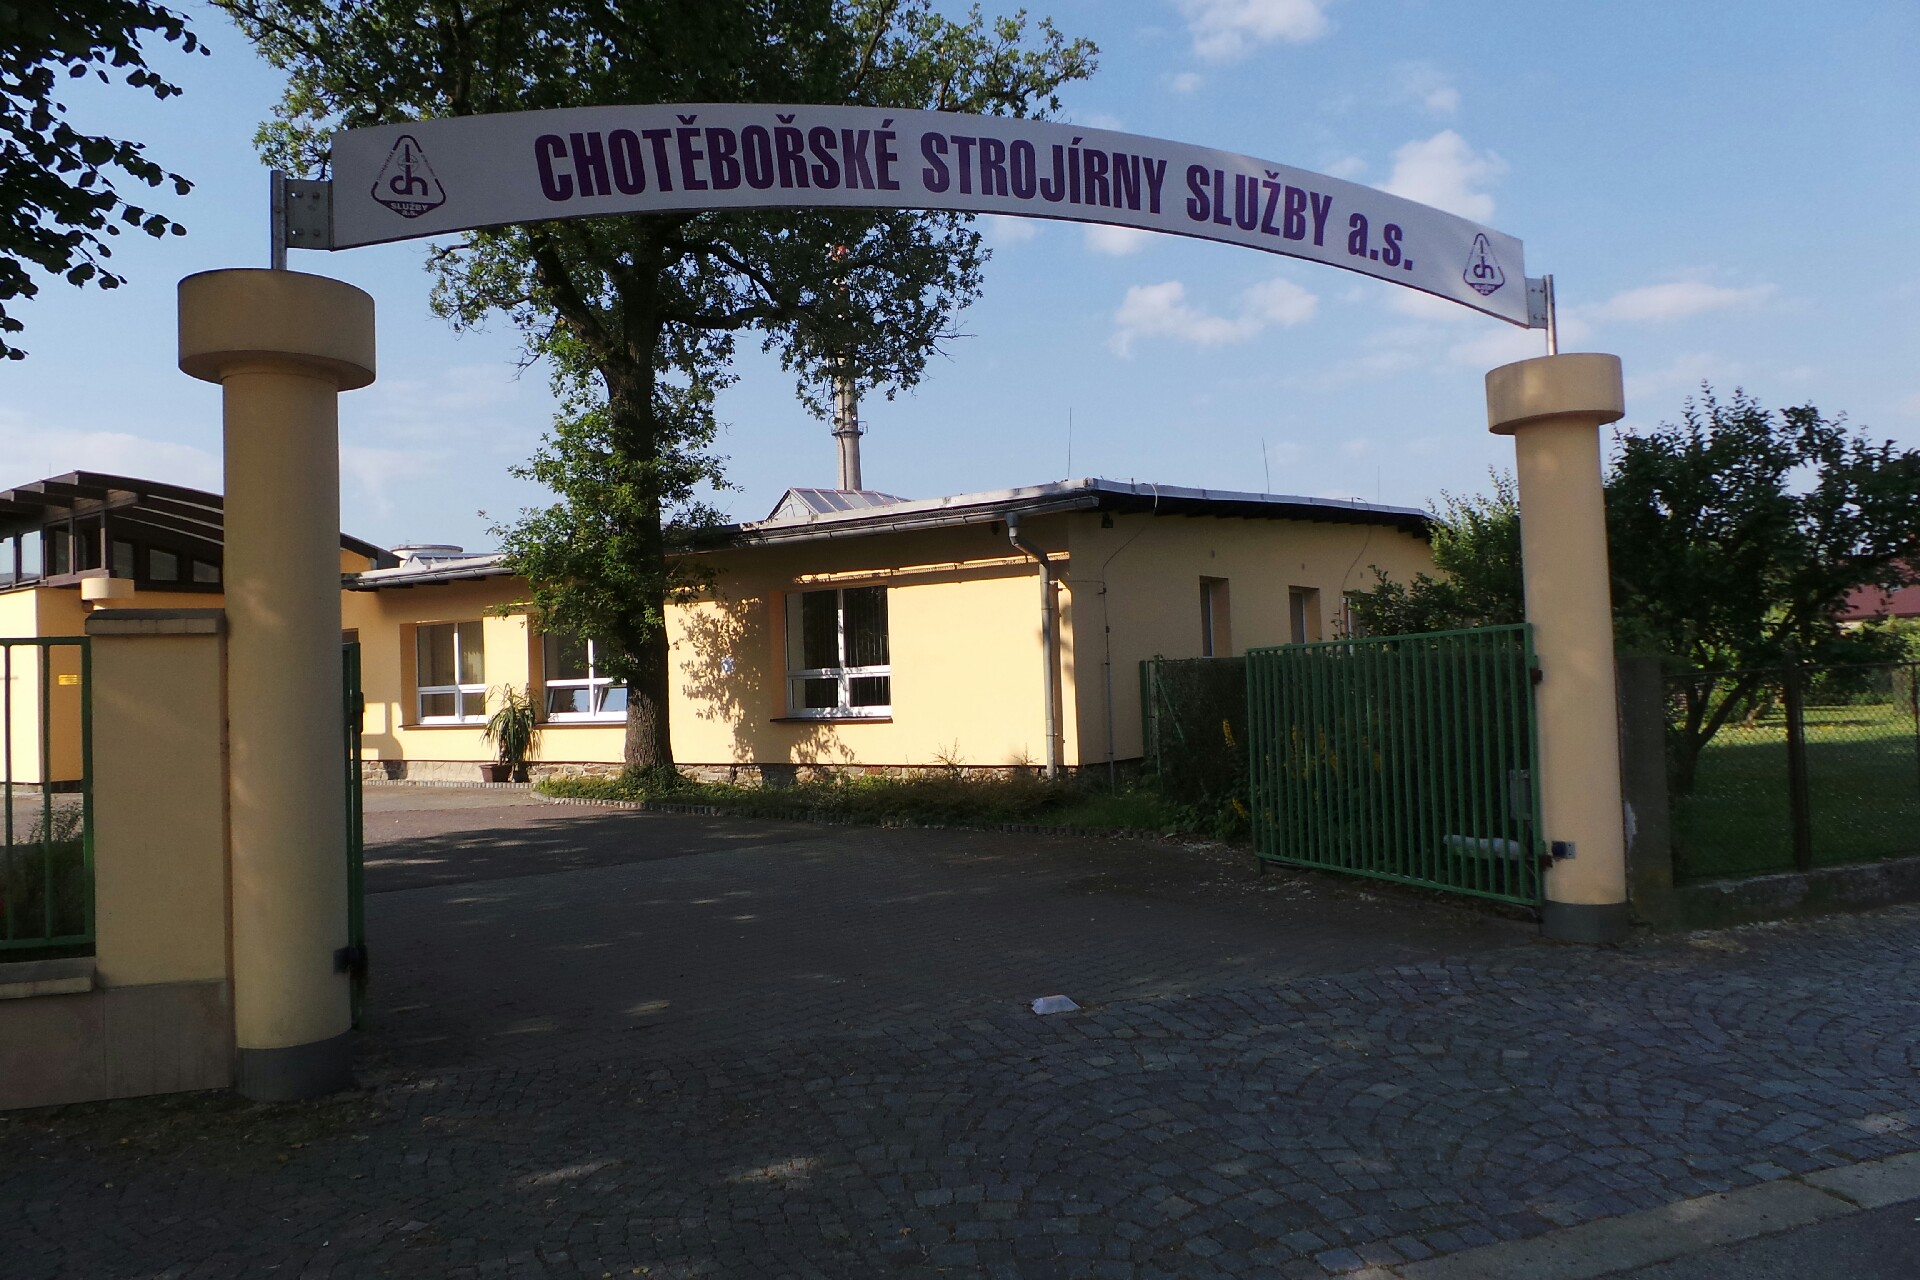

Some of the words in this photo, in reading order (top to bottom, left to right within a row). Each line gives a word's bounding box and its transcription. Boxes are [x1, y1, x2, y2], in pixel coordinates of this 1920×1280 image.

[535, 114, 899, 201] CHOTĚBOŘSKÉ
[921, 132, 1167, 214] STROJÍRNY
[1187, 165, 1332, 246] SLUŽBY
[1348, 213, 1412, 270] a.s.
